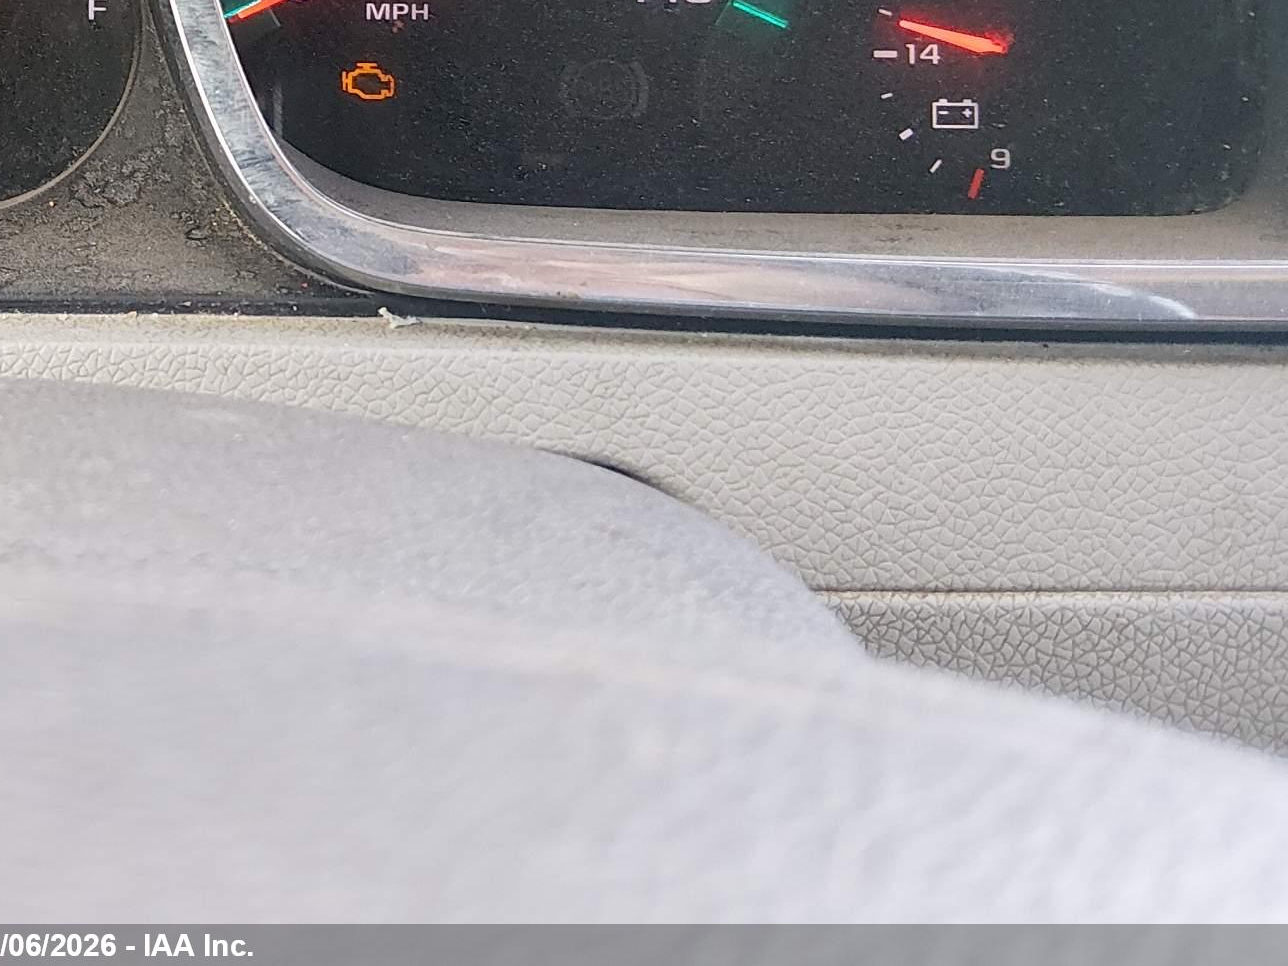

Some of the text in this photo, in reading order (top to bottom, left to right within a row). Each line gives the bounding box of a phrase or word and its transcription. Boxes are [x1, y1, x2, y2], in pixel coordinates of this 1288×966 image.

[366, 2, 429, 21] MPH
[905, 43, 942, 65] 14
[989, 147, 1012, 170] 9
